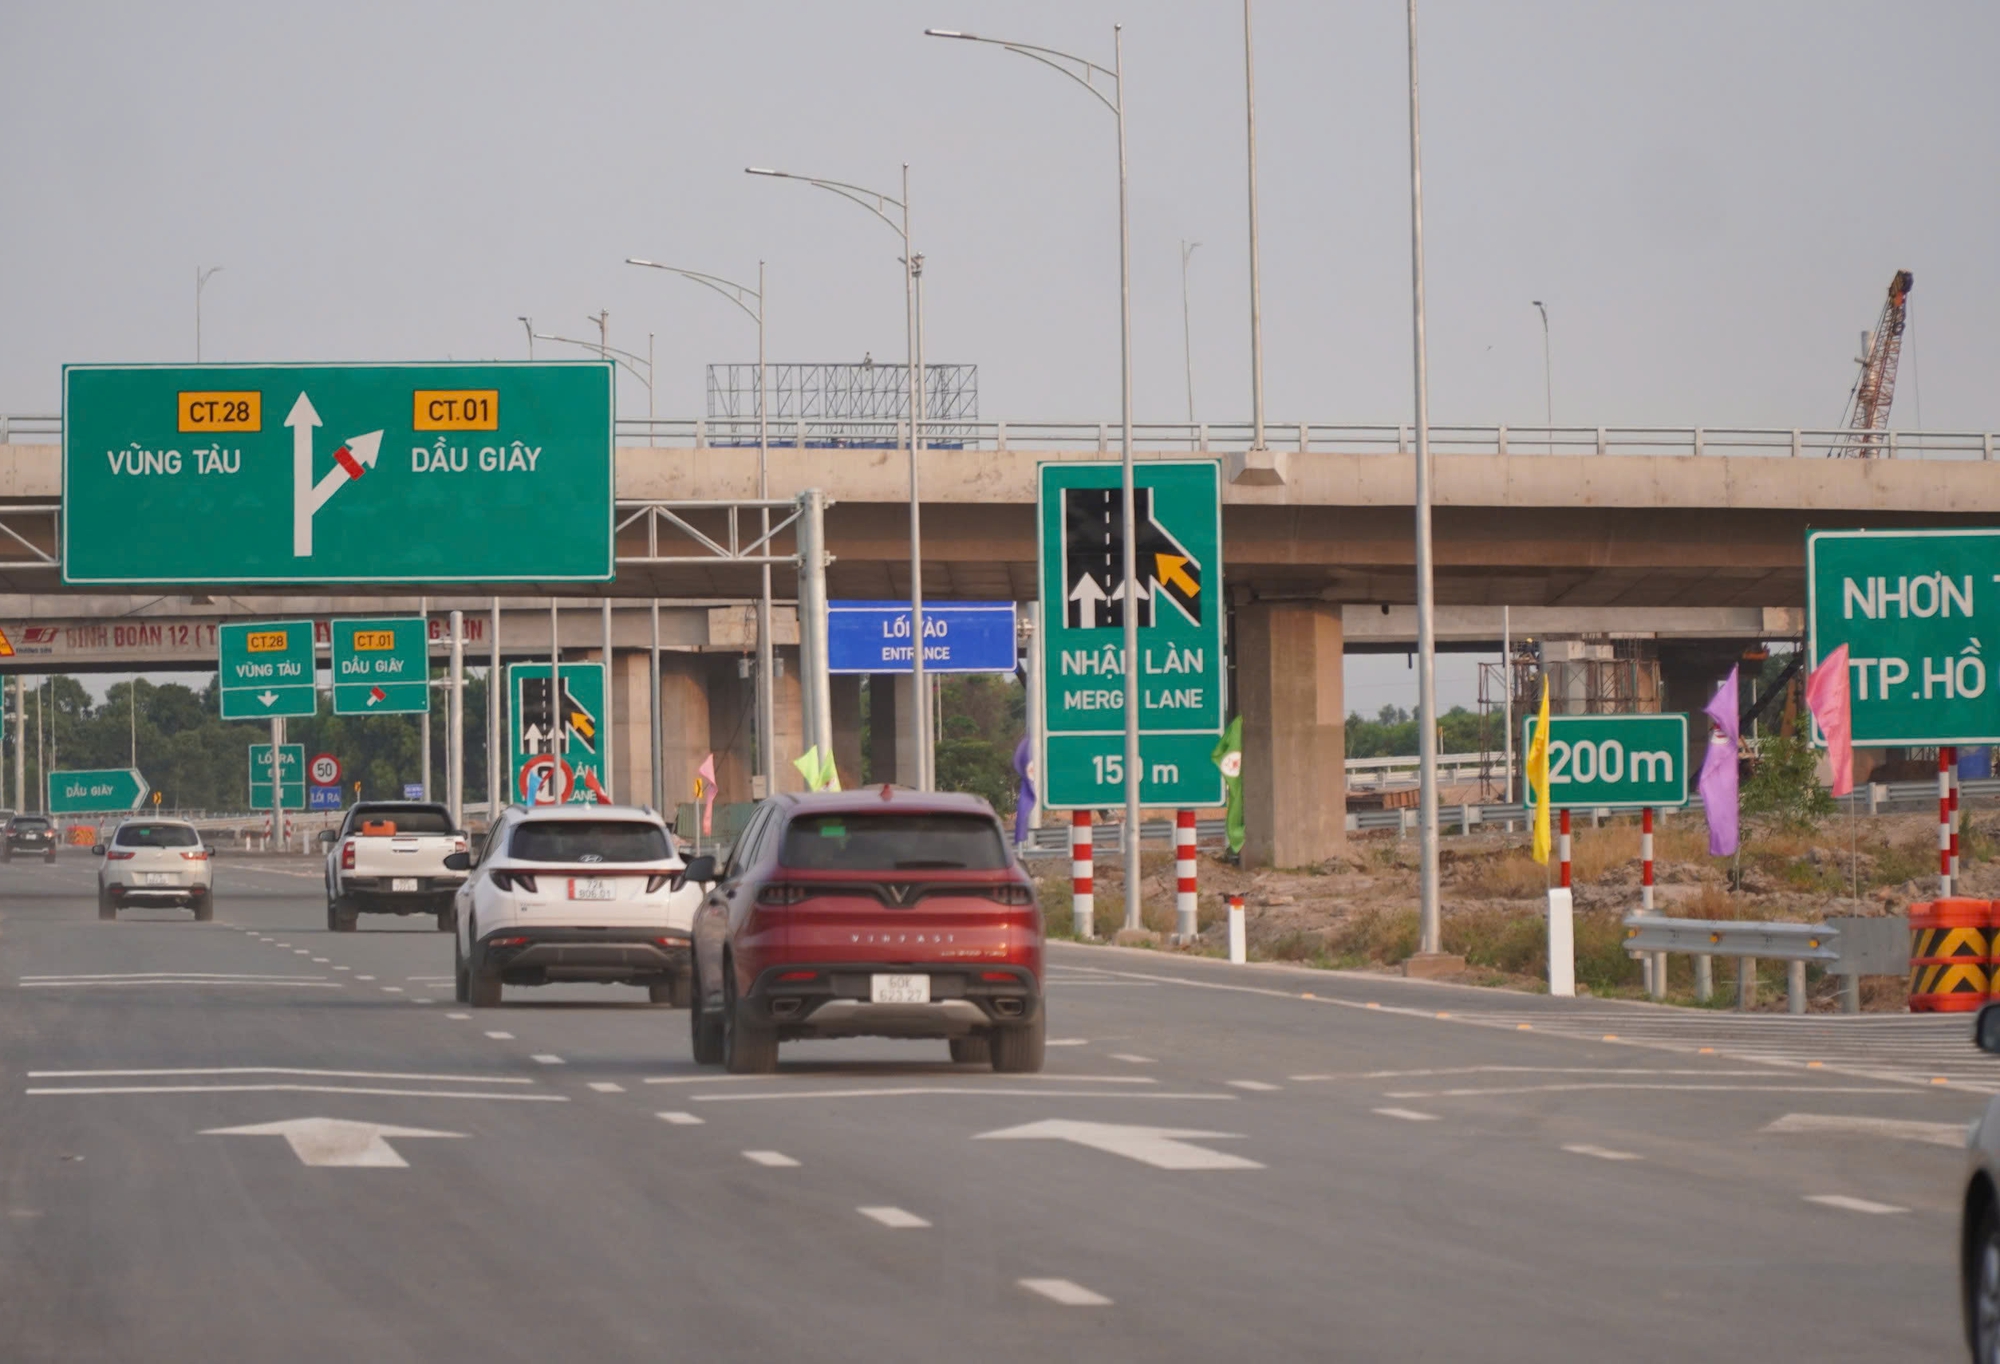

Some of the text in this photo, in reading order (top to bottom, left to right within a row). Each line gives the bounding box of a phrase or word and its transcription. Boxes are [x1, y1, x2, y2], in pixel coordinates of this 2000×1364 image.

[189, 401, 249, 424] CT.28
[428, 399, 488, 422] CT.01
[107, 443, 241, 475] VŨNG TÀU
[411, 437, 542, 473] DẦU GIÂY
[1843, 570, 1974, 619] NHƠN
[883, 614, 948, 638] LỐI ÀO
[250, 635, 285, 649] CT.28
[356, 634, 392, 647] CT.01
[341, 655, 405, 674] DẦU GIÂY
[882, 646, 950, 661] ENTRNCE
[1145, 641, 1204, 674] LÀN
[235, 660, 274, 678] VŨNG
[1064, 688, 1204, 710] MERG LANE
[258, 749, 274, 764] LỐ
[1548, 739, 1674, 784] 200 m
[317, 762, 333, 778] 50
[1152, 764, 1179, 784] m
